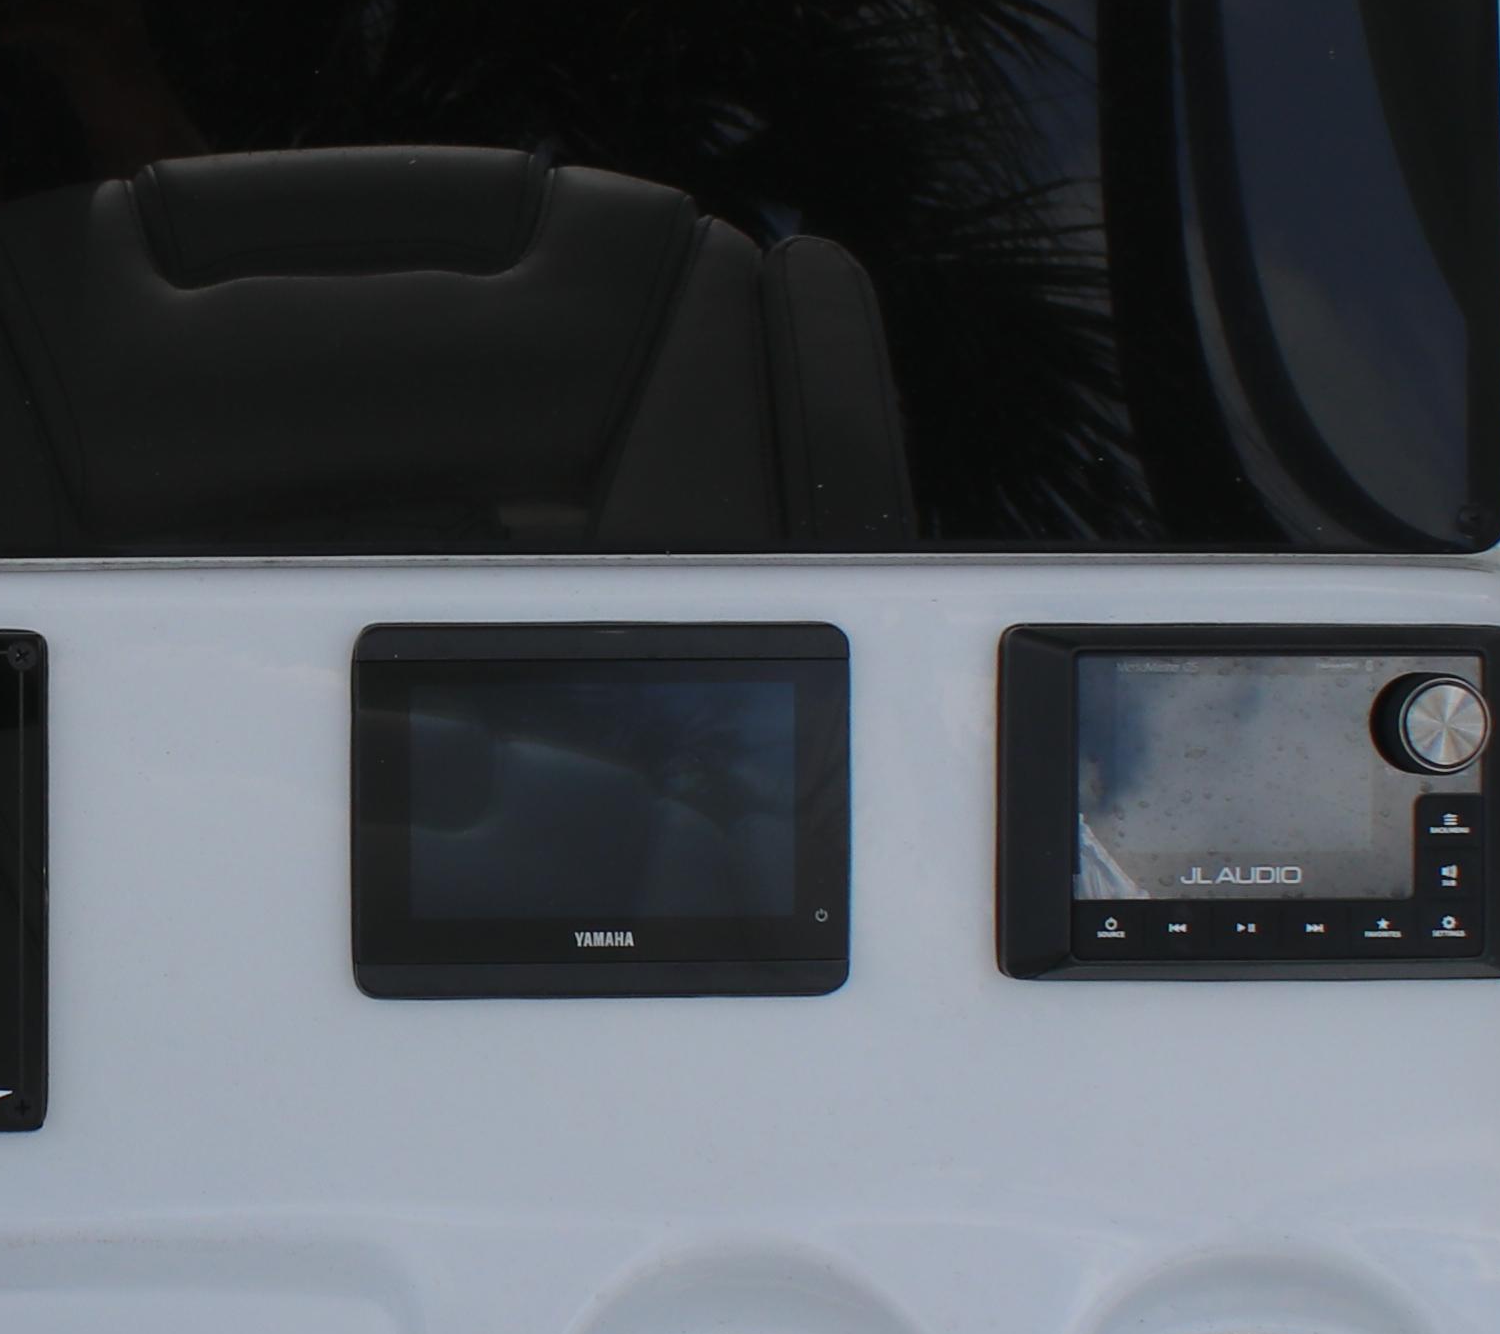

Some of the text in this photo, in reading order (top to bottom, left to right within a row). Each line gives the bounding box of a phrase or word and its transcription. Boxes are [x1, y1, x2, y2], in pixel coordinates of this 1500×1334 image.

[1180, 866, 1302, 884] JL AUDIO
[574, 932, 634, 947] YAMAHA
